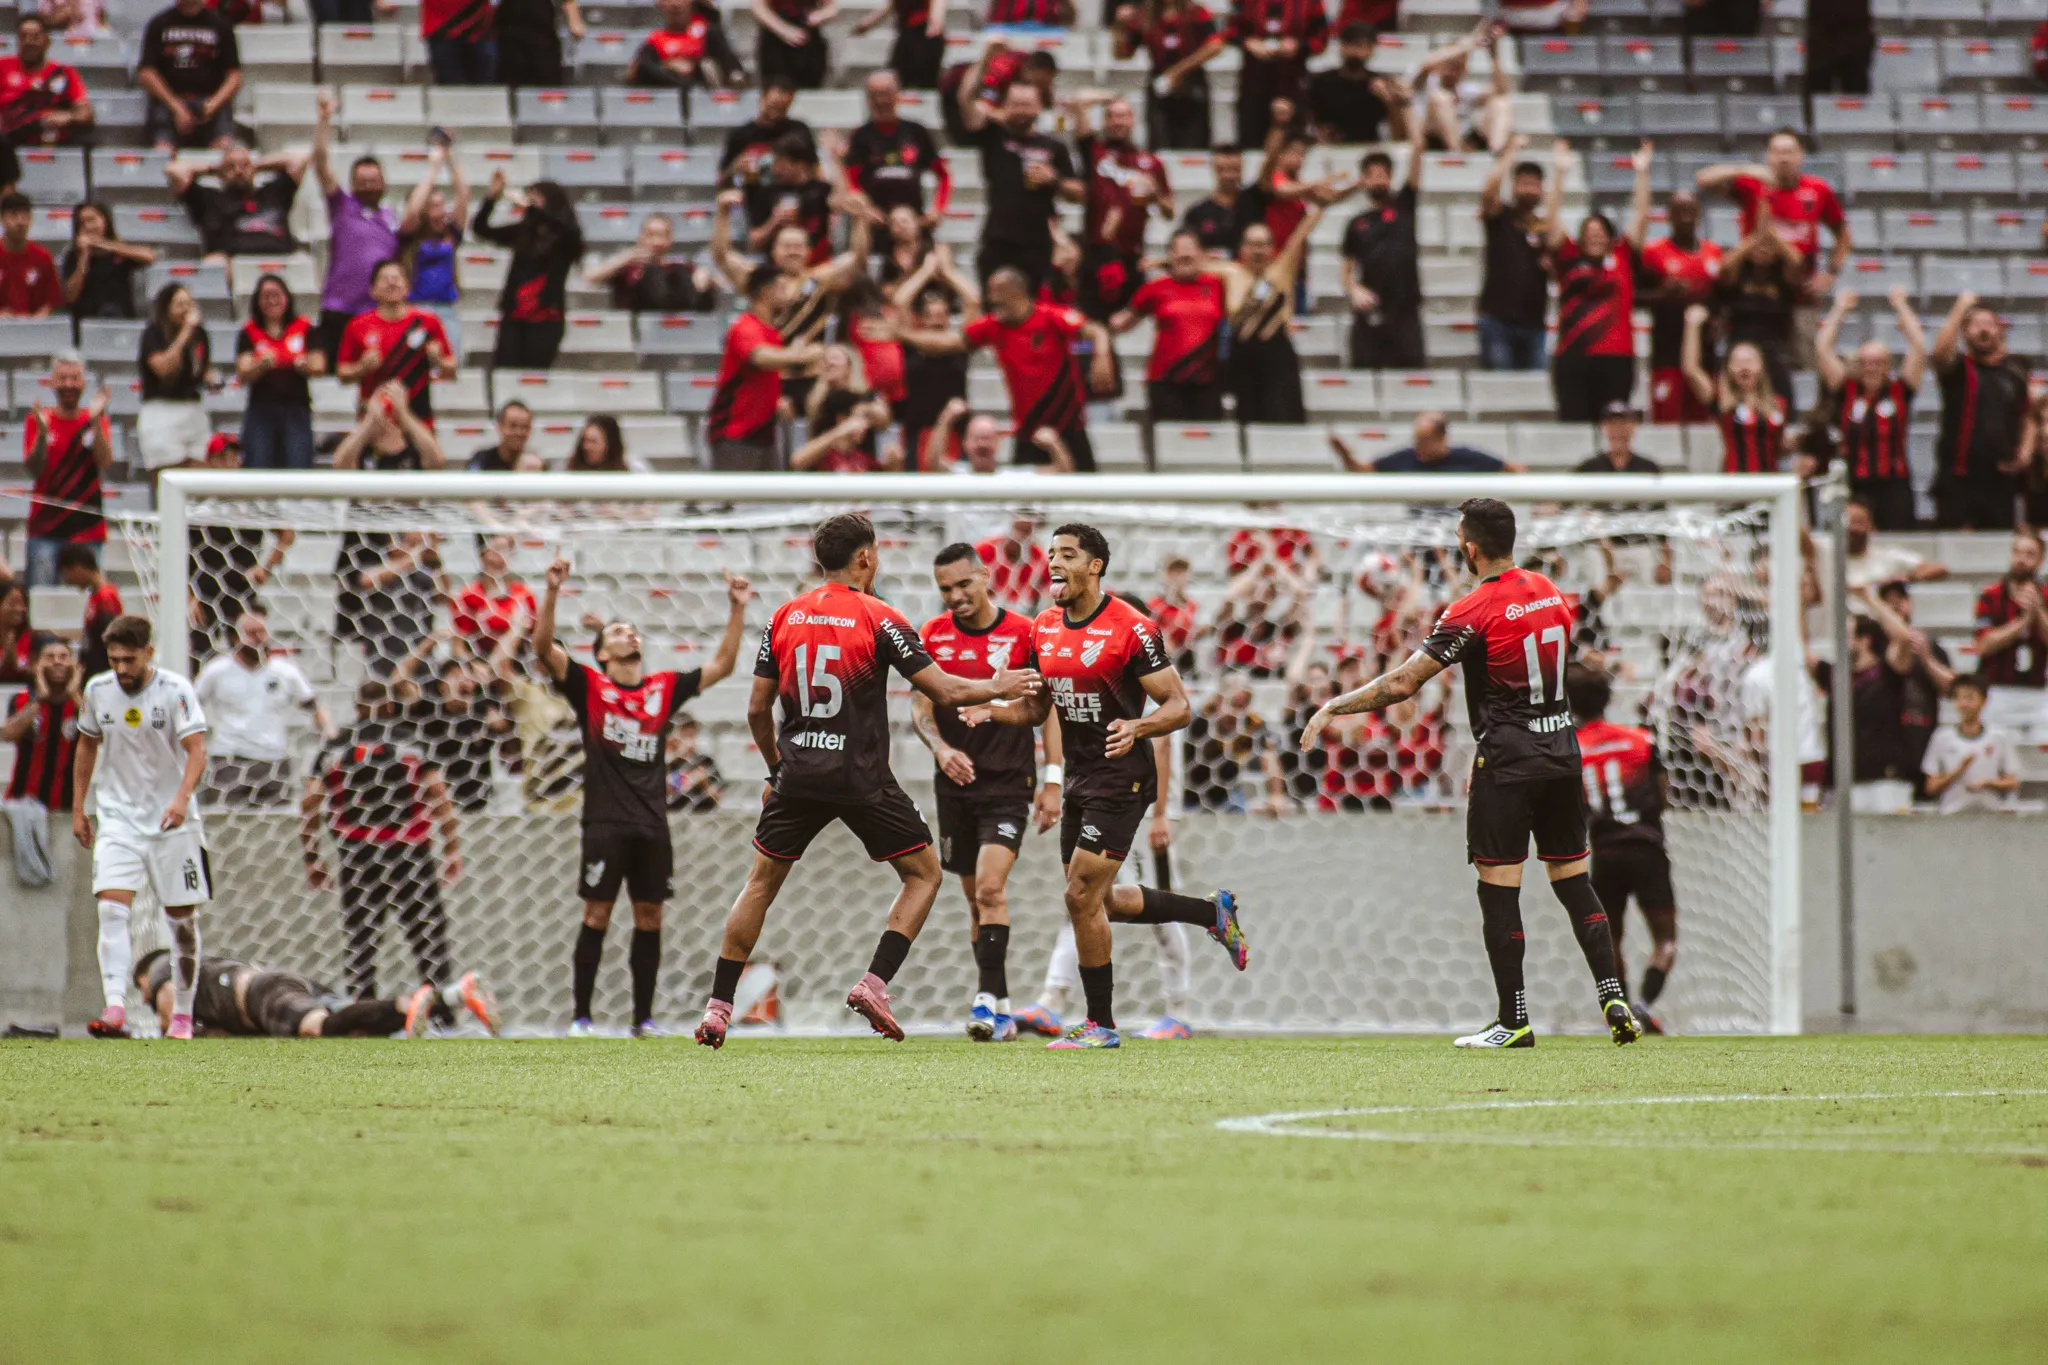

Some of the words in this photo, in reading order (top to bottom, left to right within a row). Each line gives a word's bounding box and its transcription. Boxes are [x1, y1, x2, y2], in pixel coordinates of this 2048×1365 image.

[806, 615, 856, 628] ADEMICON
[880, 618, 913, 659] HAVAN
[1132, 622, 1162, 668] HAVAN
[1523, 625, 1565, 705] 17
[795, 643, 843, 718] 15
[1044, 677, 1074, 693] IVA
[1065, 707, 1102, 723] .BET
[1583, 758, 1626, 815] 11
[184, 870, 198, 890] 18
